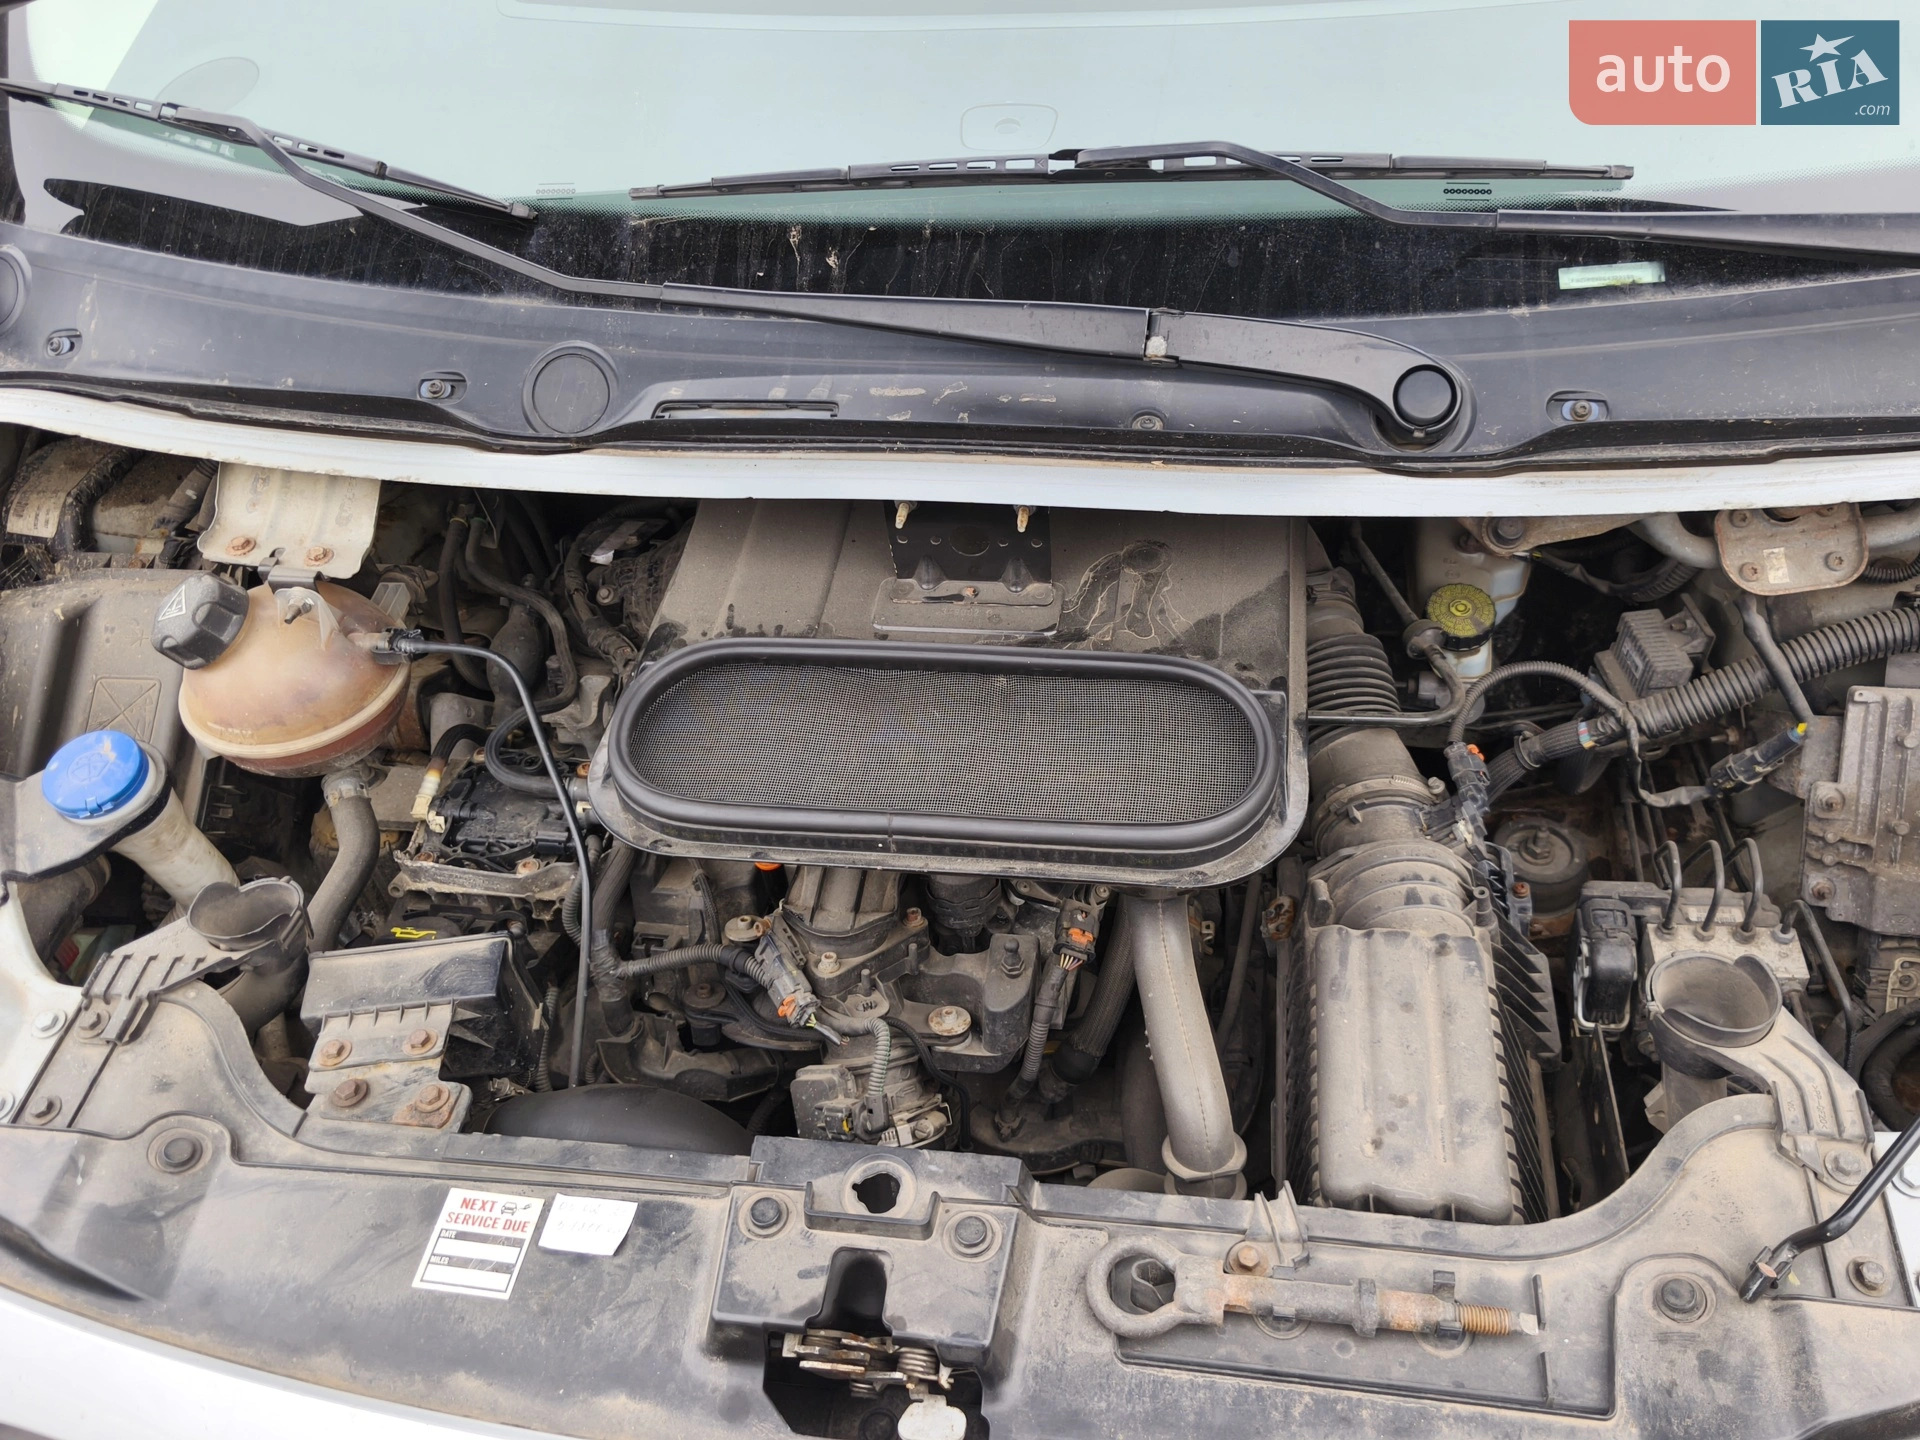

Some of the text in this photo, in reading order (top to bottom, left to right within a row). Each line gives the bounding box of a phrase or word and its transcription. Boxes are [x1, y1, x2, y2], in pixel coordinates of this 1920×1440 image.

[460, 1197, 498, 1212] NEXT
[445, 1211, 531, 1233] SERVICE DUE
[439, 1229, 457, 1239] DATE
[430, 1255, 450, 1265] MILES
